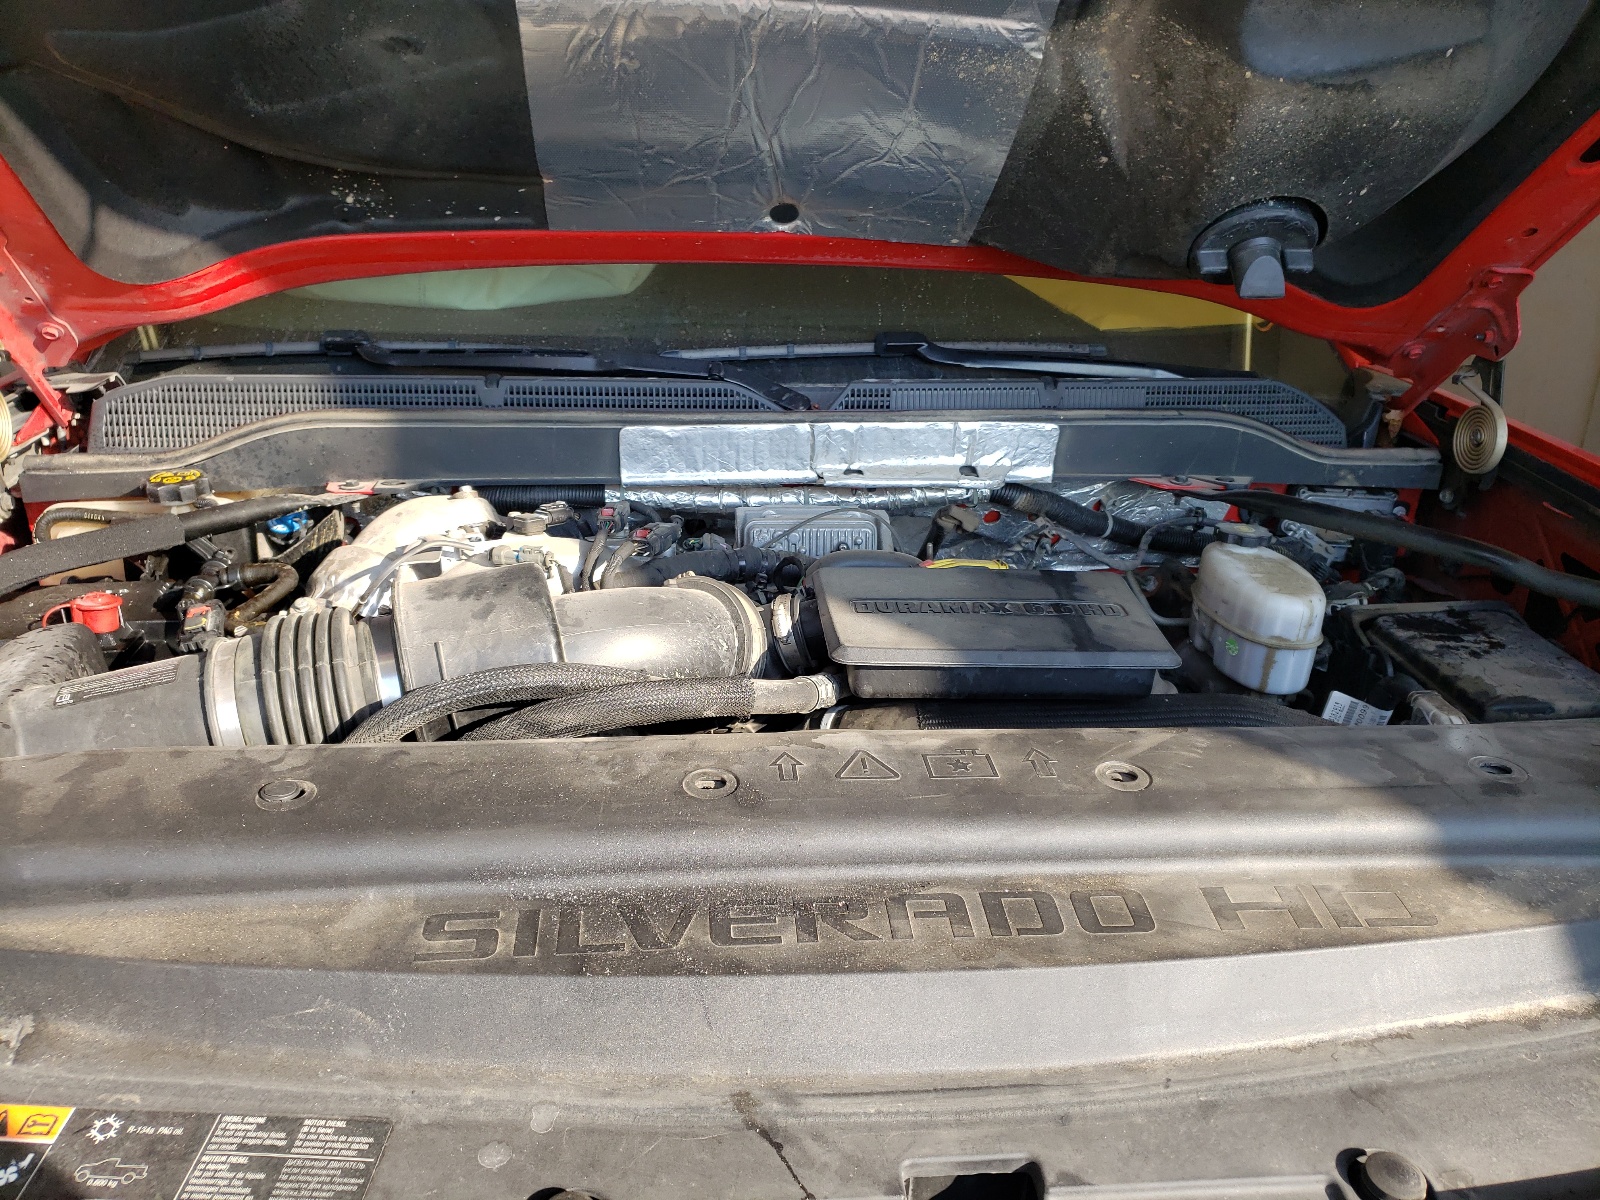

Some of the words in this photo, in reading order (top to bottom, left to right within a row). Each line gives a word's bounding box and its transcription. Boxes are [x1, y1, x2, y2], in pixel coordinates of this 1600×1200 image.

[853, 600, 1014, 615] DURAMAX
[1078, 603, 1124, 617] HD
[415, 889, 1156, 963] SILVERADO
[1200, 884, 1437, 931] HD
[126, 1126, 155, 1134] R-134a
[200, 1155, 228, 1163] MOTEUR
[227, 1156, 249, 1164] DIESEL
[328, 1160, 366, 1169] ДВИГАТЕЛЬ
